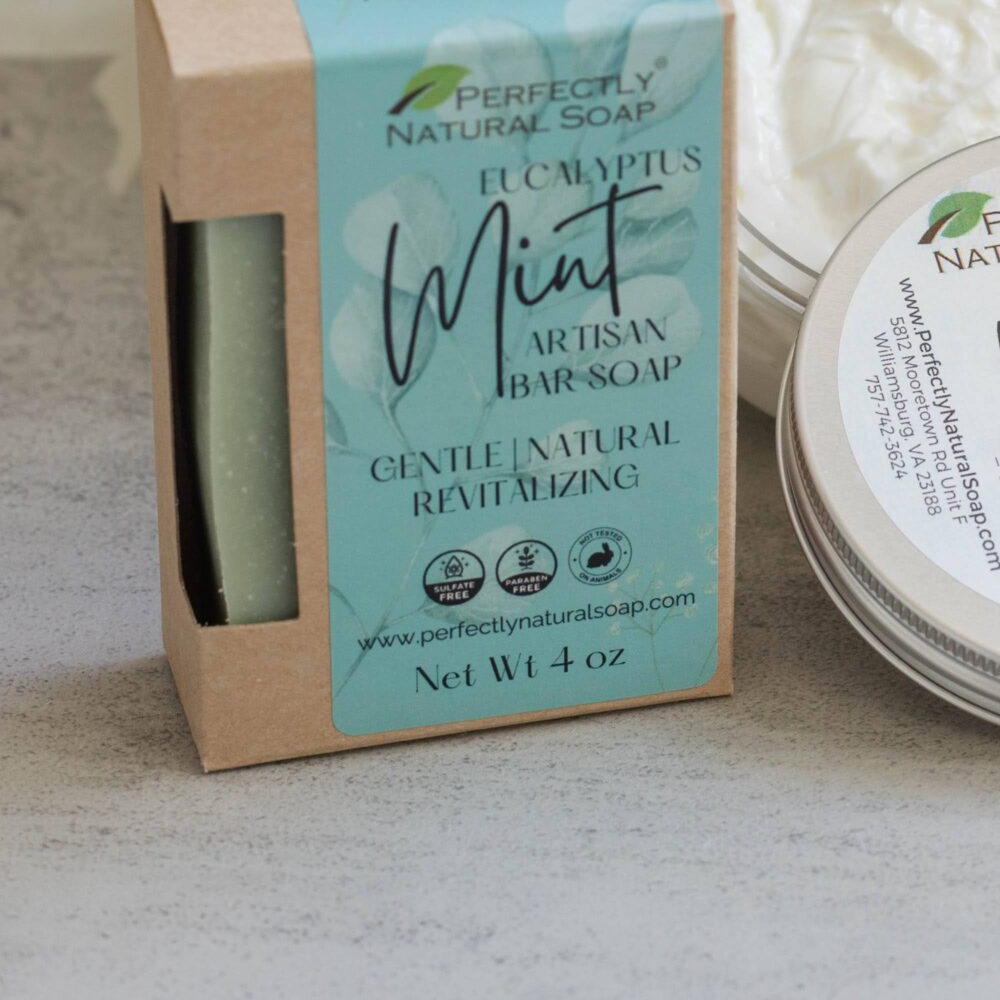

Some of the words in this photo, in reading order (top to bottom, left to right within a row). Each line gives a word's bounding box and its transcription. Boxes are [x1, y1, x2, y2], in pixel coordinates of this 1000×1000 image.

[386, 113, 549, 148] NATURAL
[560, 100, 657, 130] SOAP
[480, 145, 702, 196] EUCALYPTUS
[383, 183, 663, 397] Mint
[526, 316, 668, 357] ARTISAN
[890, 316, 912, 350] 5812
[511, 368, 578, 399] BAR
[589, 355, 682, 390] SOAP
[902, 355, 939, 446] Mooretown
[865, 374, 906, 480] 757-742-3624
[370, 440, 503, 483] GENTLE
[527, 419, 681, 461] NATURAL
[908, 443, 926, 469] VA
[932, 451, 950, 472] Rd
[412, 463, 641, 517] REVITALIZING
[915, 472, 942, 517] 23188
[940, 477, 961, 513] Unit
[578, 532, 594, 546] NOT
[594, 530, 623, 542] TESTED
[953, 513, 968, 525] F
[434, 581, 475, 594] SULFATE
[505, 574, 549, 587] PARABEN
[513, 582, 541, 594] FREE
[578, 572, 589, 581] ON
[589, 567, 622, 583] ANIMALS
[439, 590, 470, 602] FREE
[357, 591, 697, 651] www.perfectlynaturalsoap.com
[414, 662, 478, 693] Net
[489, 652, 538, 683] Wt
[550, 646, 575, 674] 4
[585, 647, 626, 671] oz
